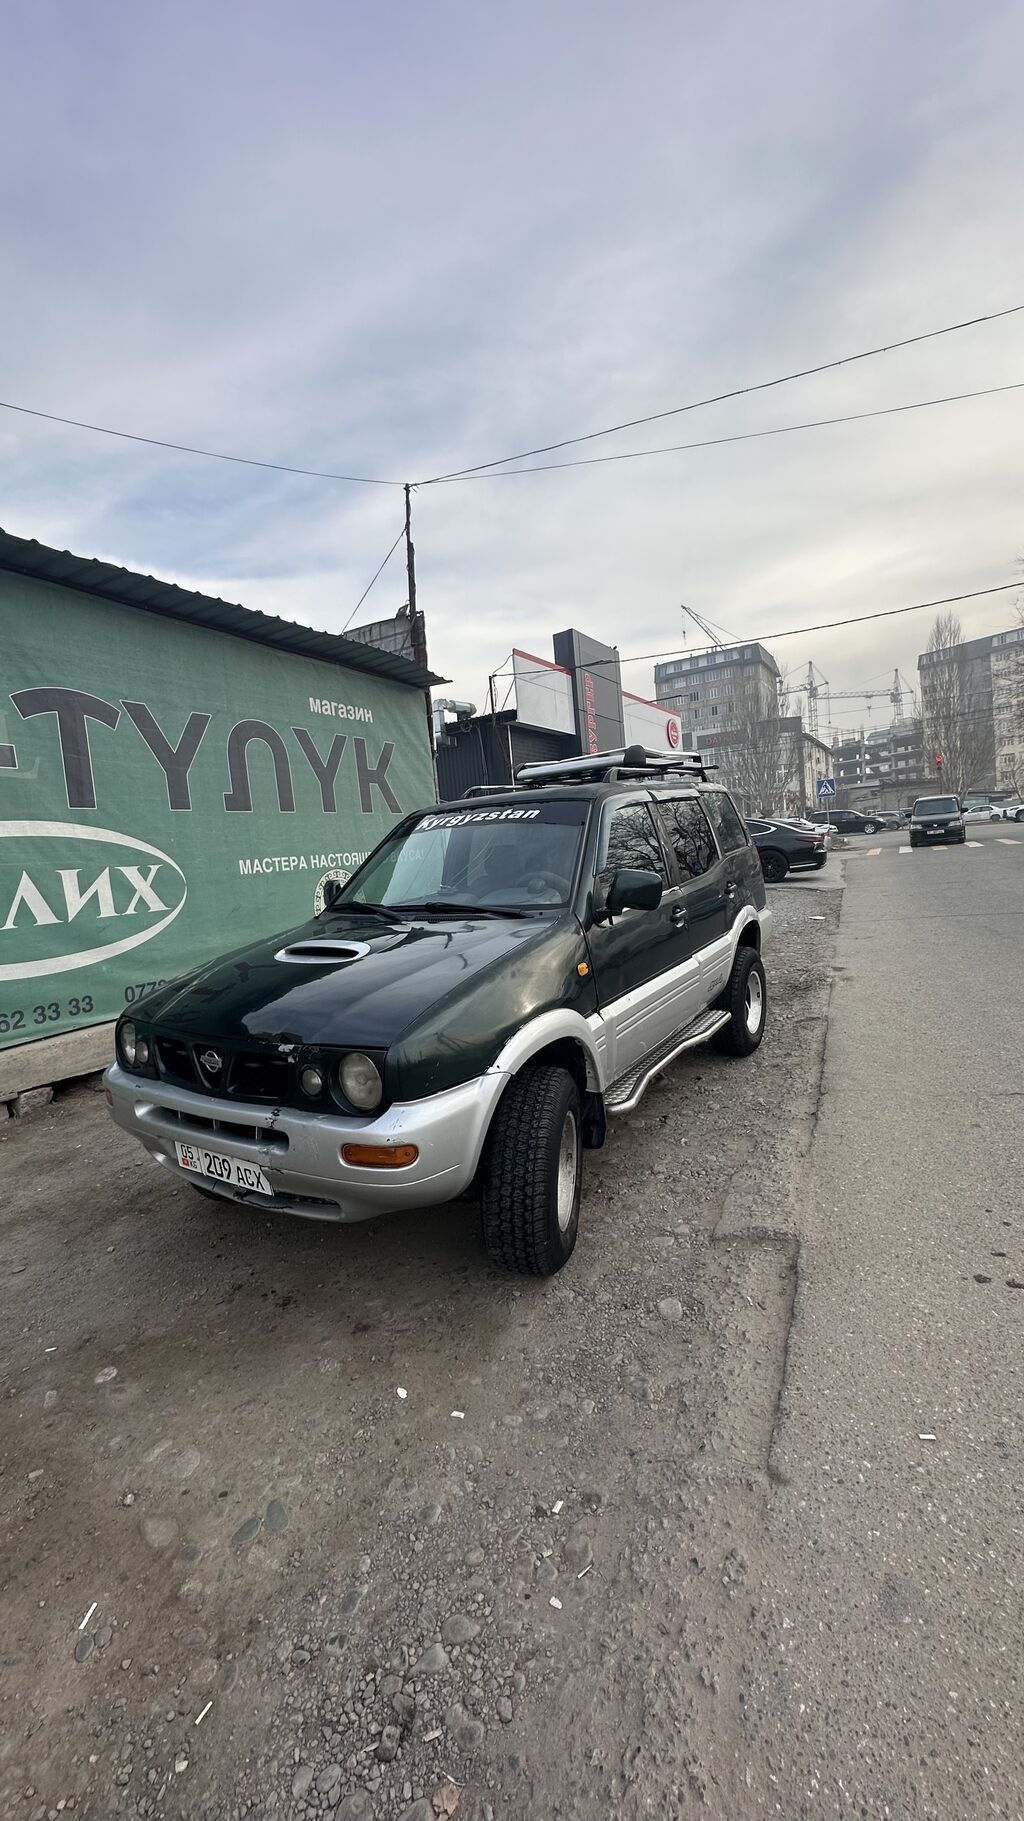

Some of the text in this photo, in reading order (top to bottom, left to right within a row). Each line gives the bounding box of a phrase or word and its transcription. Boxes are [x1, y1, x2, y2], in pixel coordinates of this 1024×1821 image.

[309, 697, 374, 723] магазин
[414, 808, 541, 831] Kyrgyzstan
[238, 855, 308, 875] МАСТЕРА
[310, 851, 374, 869] НАСТОЯЩ
[33, 1002, 61, 1025] 33
[68, 995, 94, 1016] 33
[181, 1144, 265, 1191] 05 209 ACX
